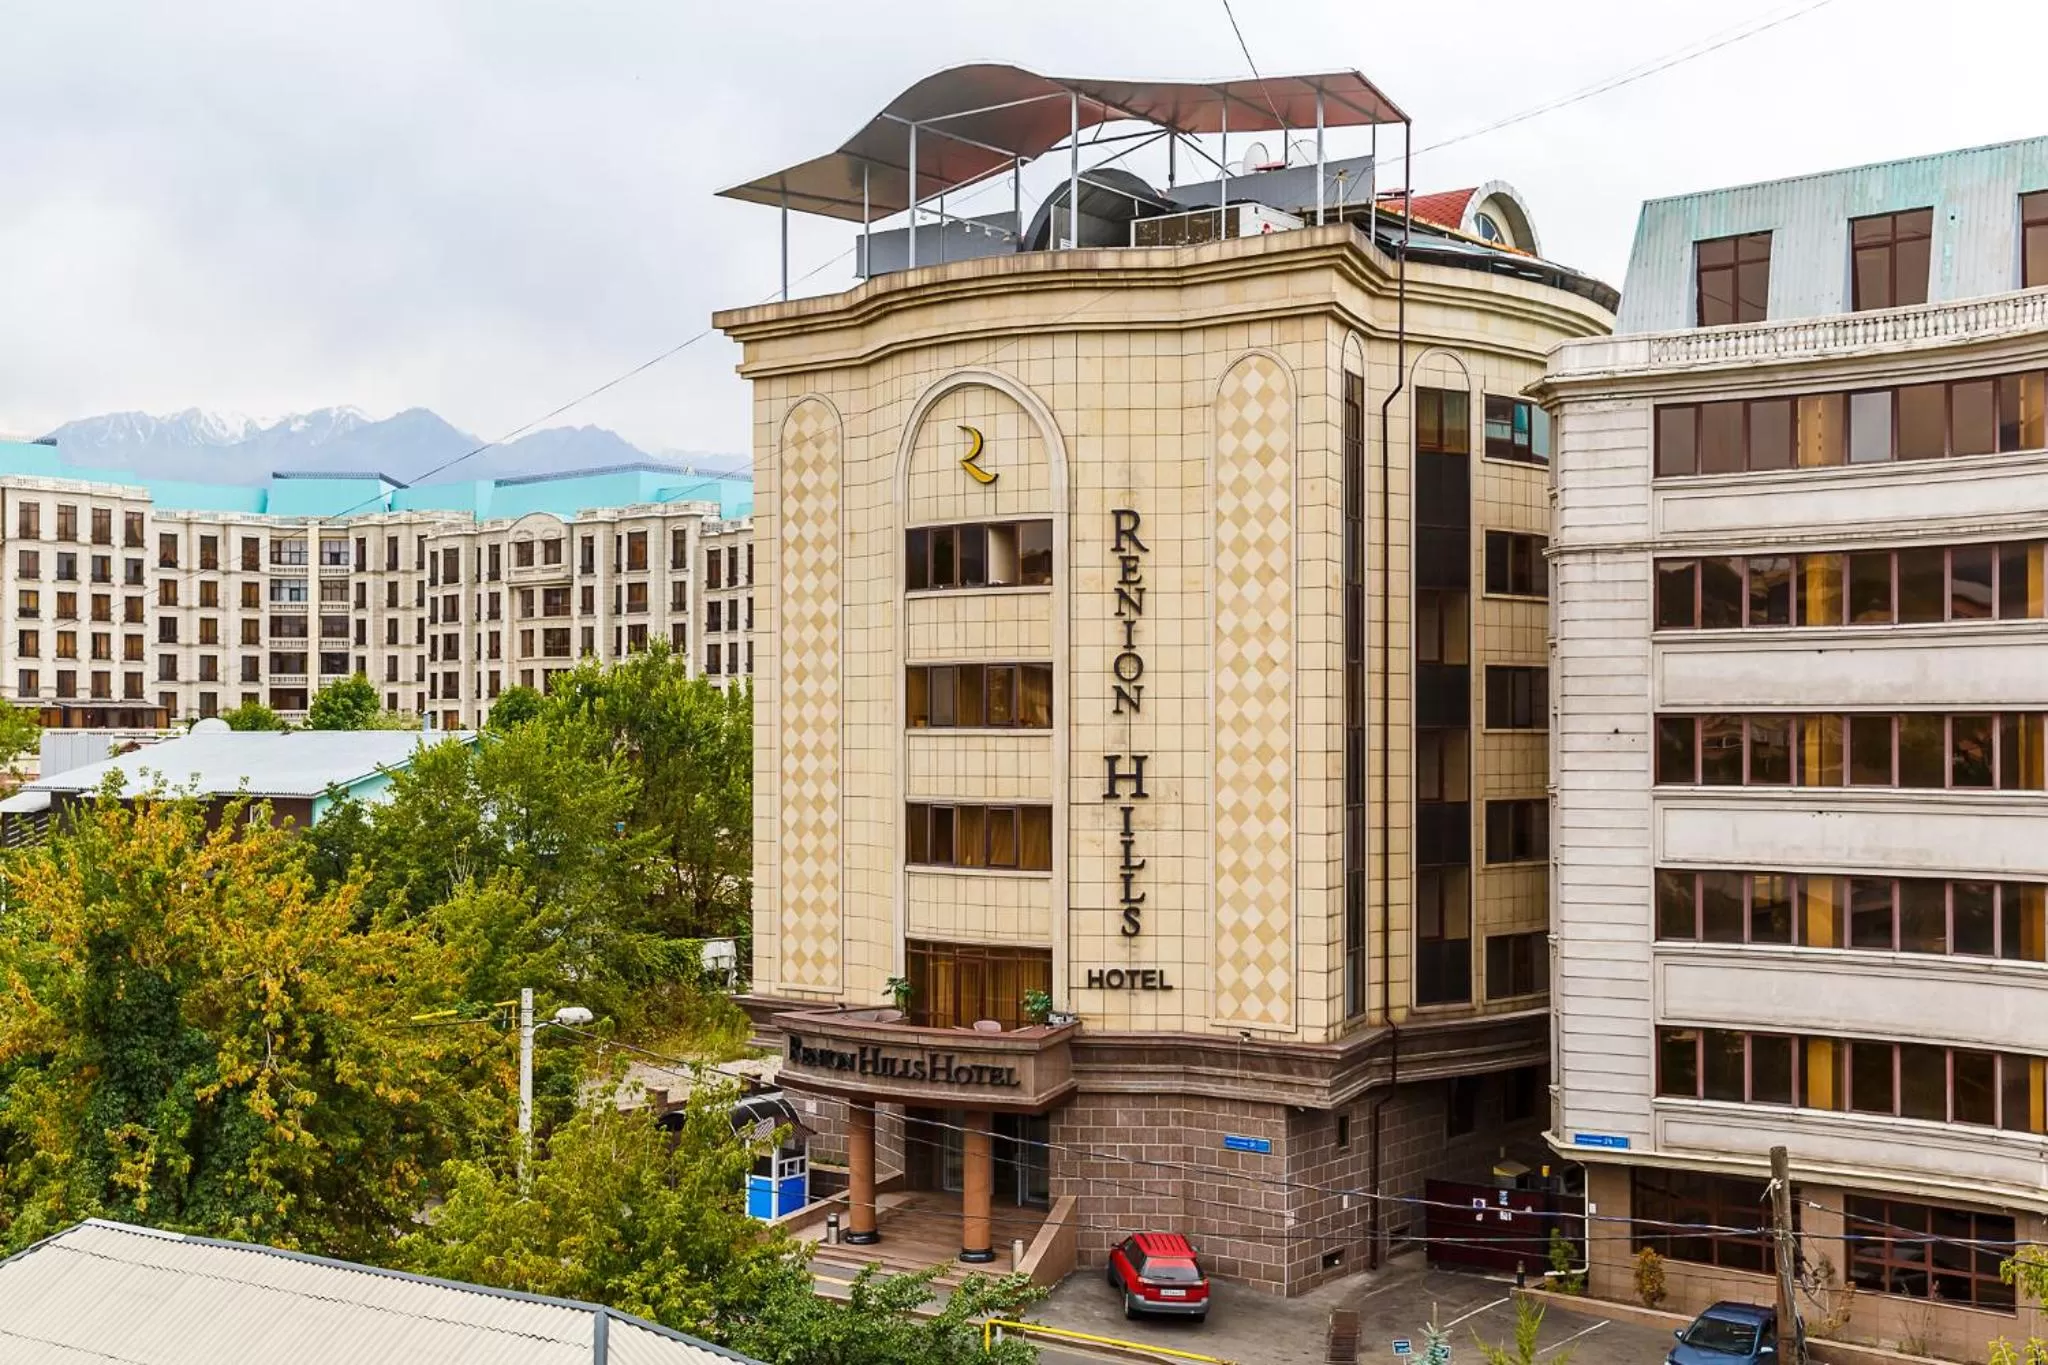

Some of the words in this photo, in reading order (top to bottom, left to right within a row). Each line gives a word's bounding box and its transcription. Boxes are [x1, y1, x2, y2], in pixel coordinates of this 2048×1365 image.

[1110, 509, 1150, 714] RENION
[1102, 754, 1149, 937] HILLS
[1087, 969, 1174, 991] HOTEL
[858, 1046, 927, 1081] HILLS
[928, 1052, 1021, 1087] HOTEL
